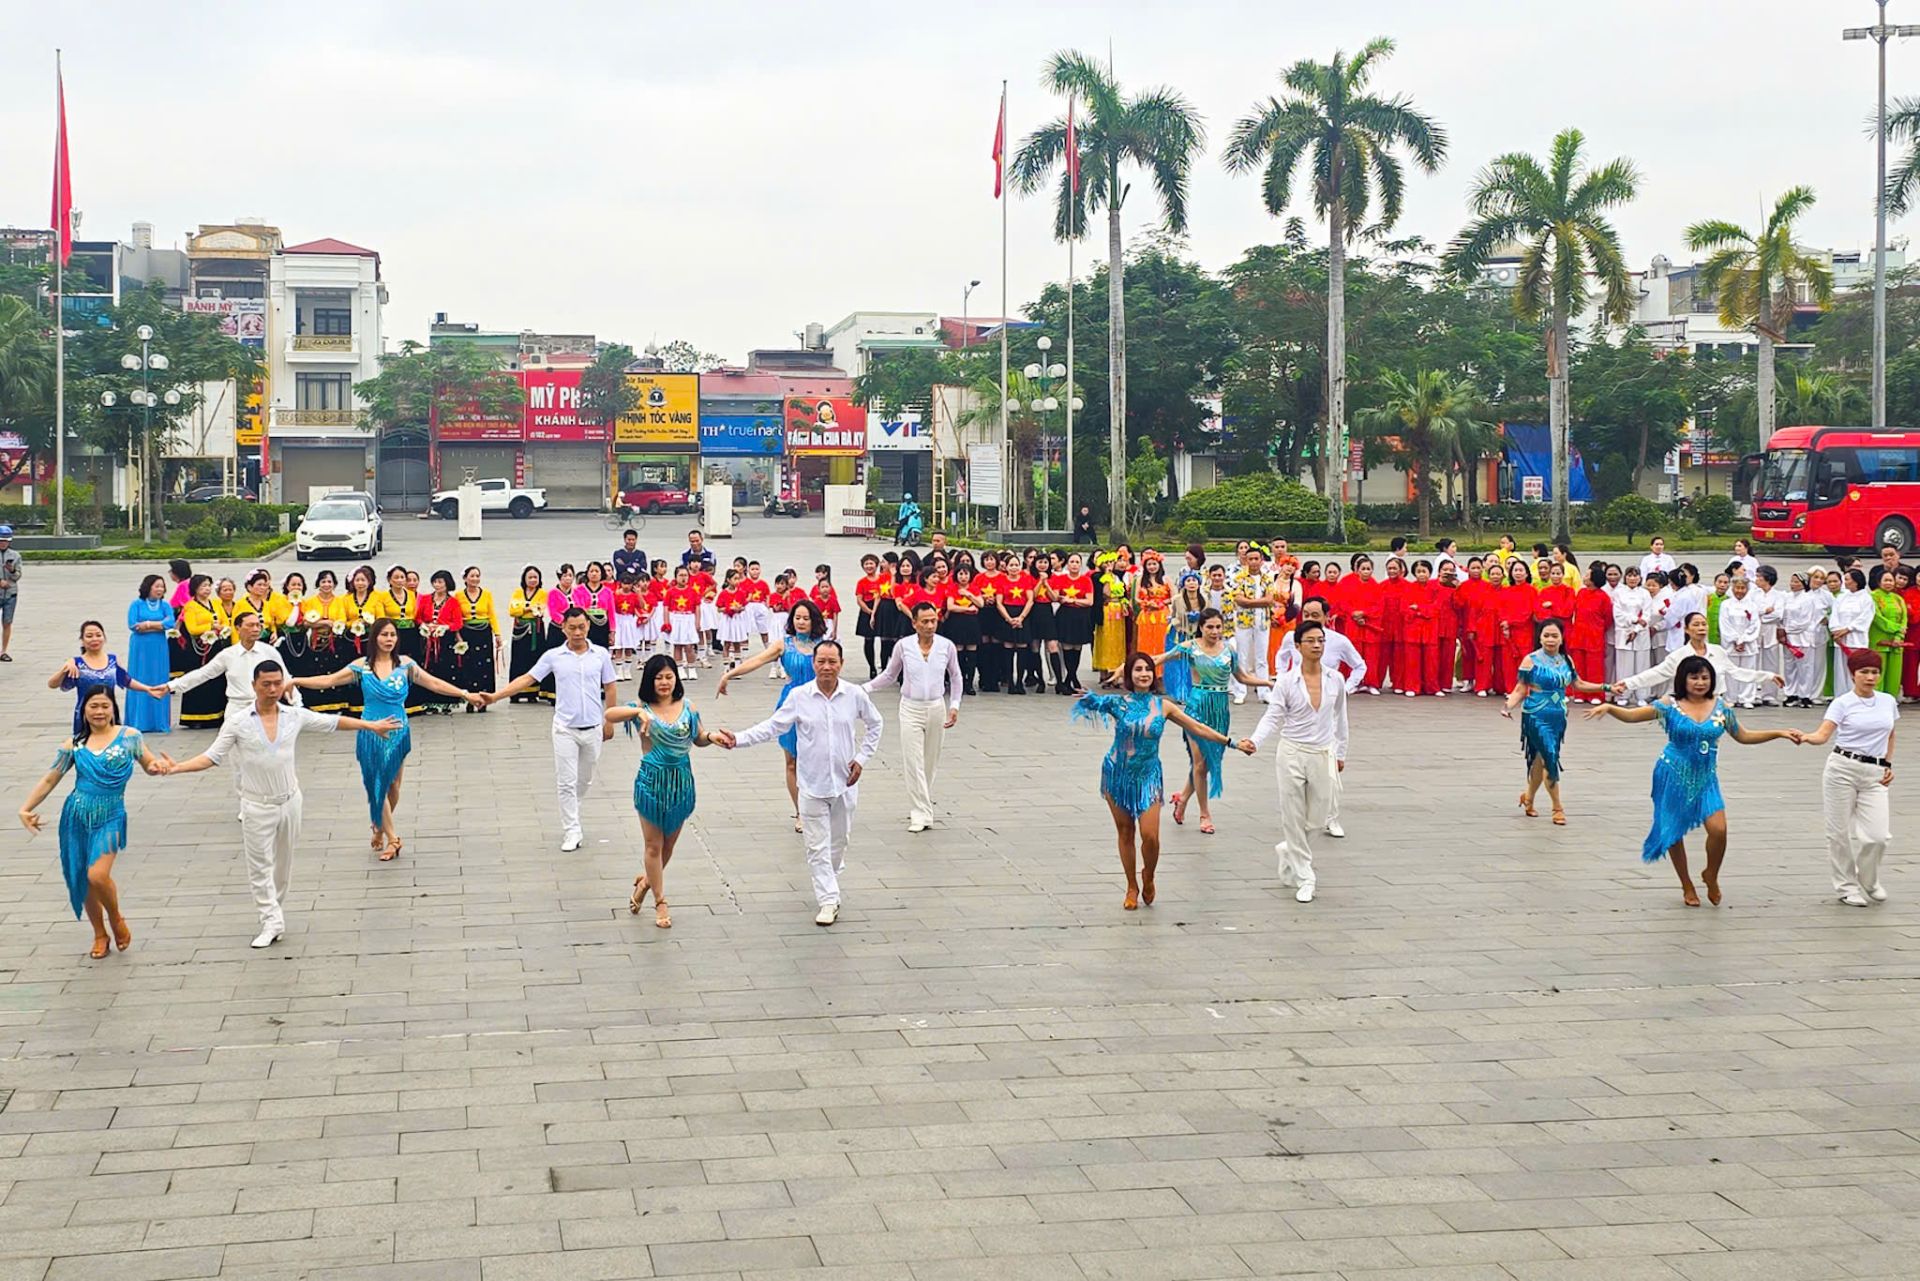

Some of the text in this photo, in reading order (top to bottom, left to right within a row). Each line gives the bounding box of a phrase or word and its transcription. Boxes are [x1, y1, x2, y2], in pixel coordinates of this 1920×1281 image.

[187, 300, 216, 311] BÁNH
[530, 382, 556, 409] MỸ
[535, 412, 577, 426] KHÁNH
[650, 410, 667, 424] TÓC
[669, 410, 692, 424] VÀNG
[701, 426, 719, 437] TH
[823, 431, 840, 446] CUA
[841, 429, 853, 446] BÀ
